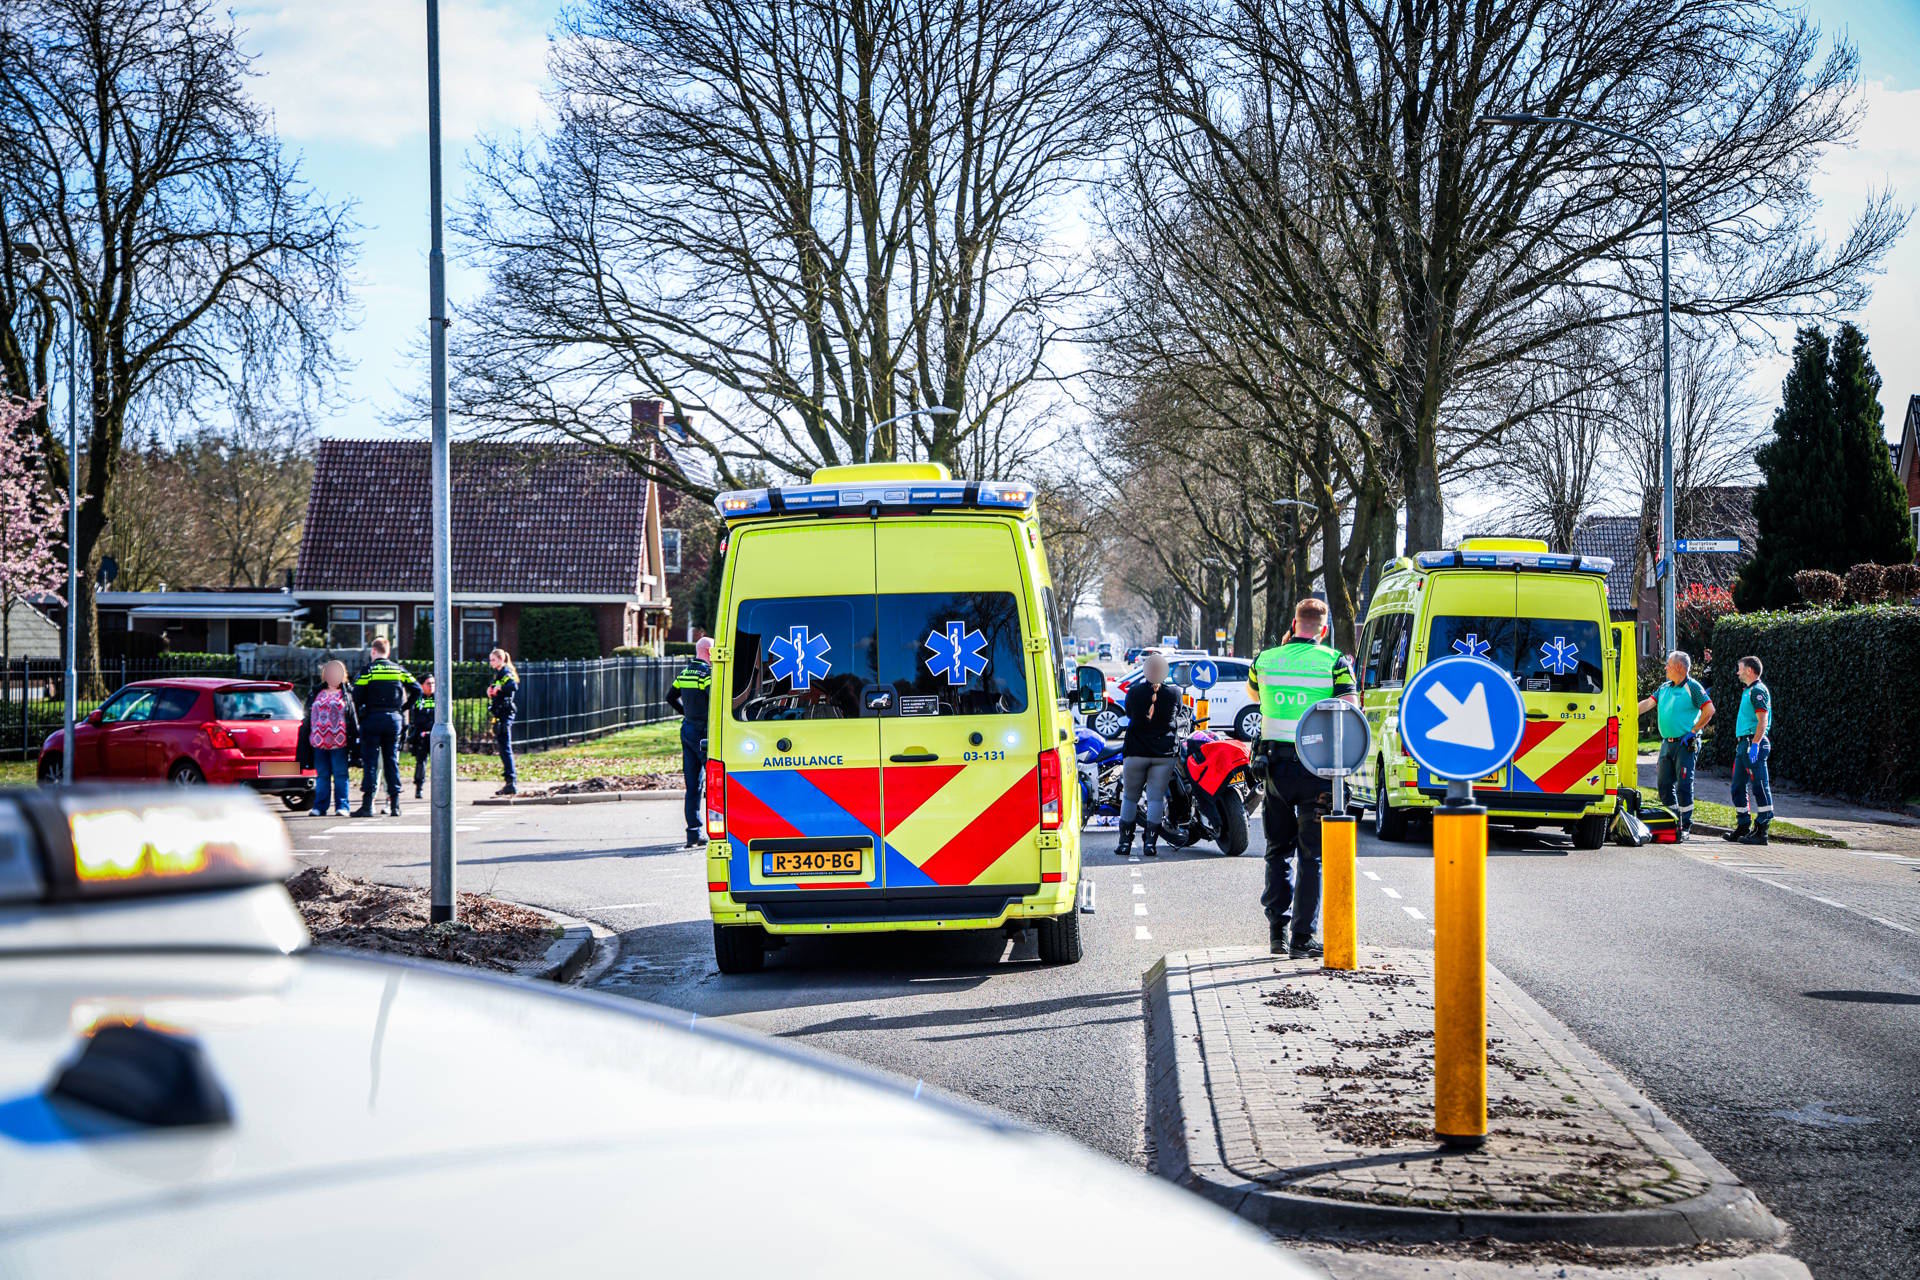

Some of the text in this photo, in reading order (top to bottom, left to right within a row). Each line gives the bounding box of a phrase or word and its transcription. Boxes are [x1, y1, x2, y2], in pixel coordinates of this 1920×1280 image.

[1274, 692, 1307, 705] OvD
[763, 755, 844, 767] AMBULANCE
[963, 751, 1005, 761] 03-131
[776, 853, 854, 870] R-340-BG
